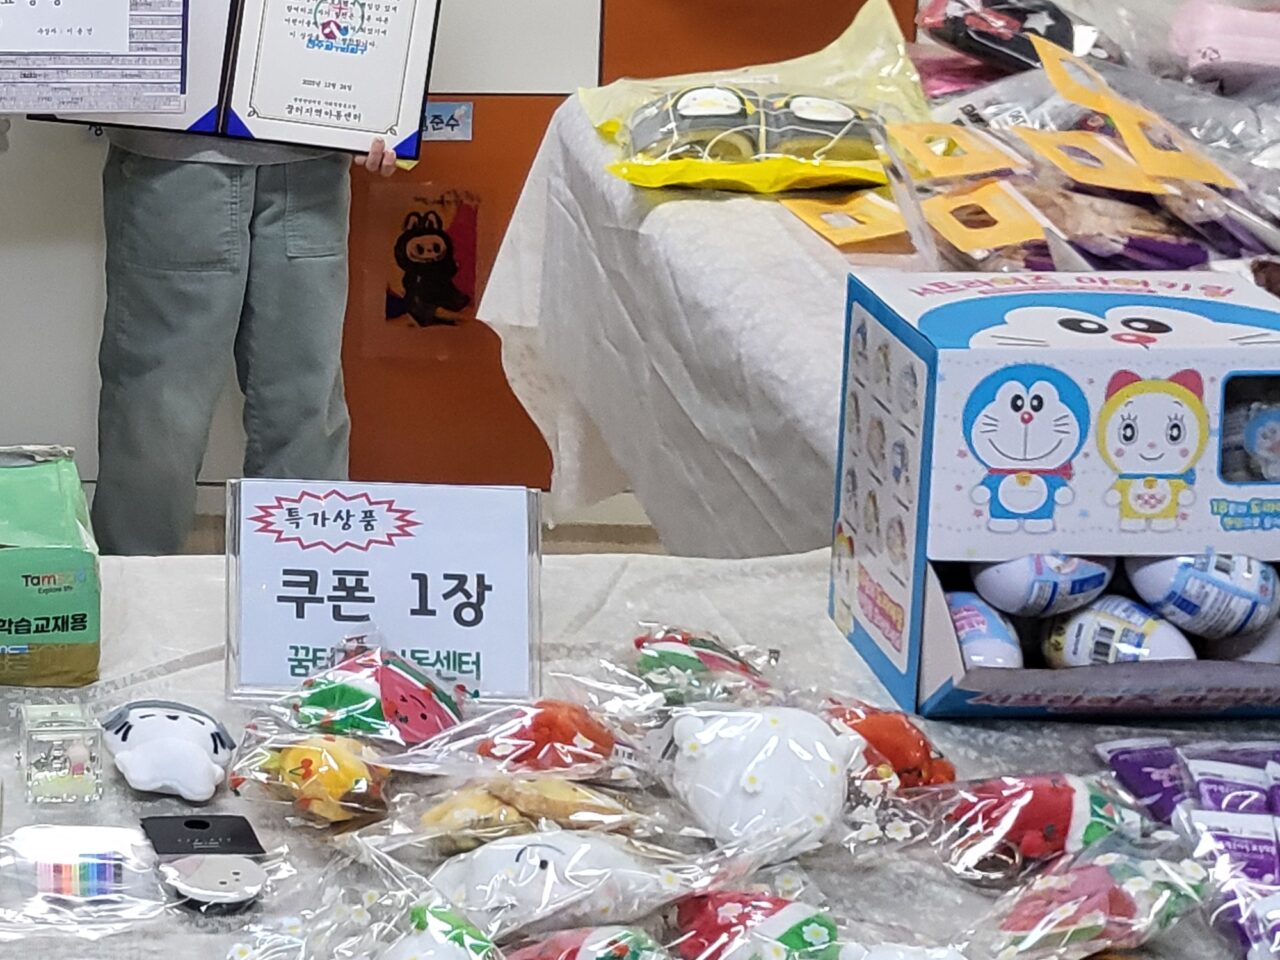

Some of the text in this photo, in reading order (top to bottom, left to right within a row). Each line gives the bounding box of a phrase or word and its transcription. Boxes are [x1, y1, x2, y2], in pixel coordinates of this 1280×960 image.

[285, 507, 378, 532] 특가상품
[277, 569, 493, 627] 쿠폰 1장
